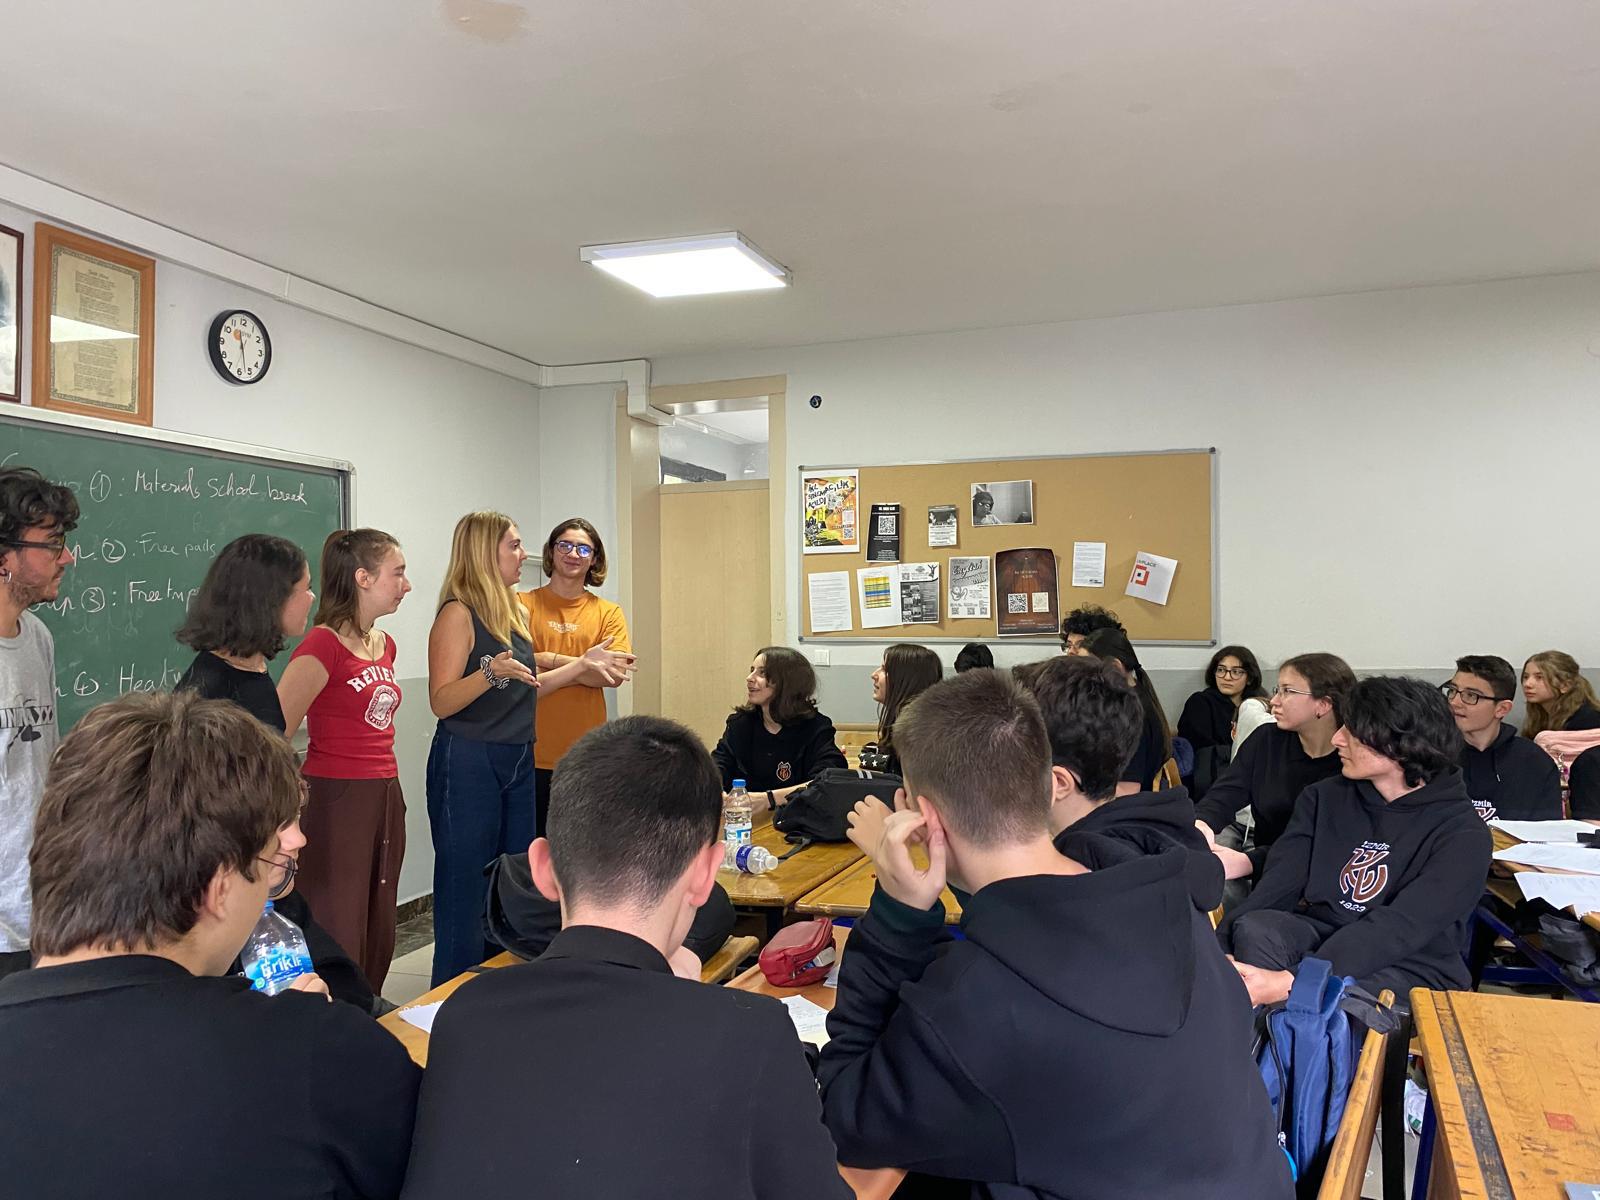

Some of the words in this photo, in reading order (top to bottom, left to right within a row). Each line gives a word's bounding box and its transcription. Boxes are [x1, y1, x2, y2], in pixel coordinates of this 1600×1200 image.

[208, 472, 259, 498] School
[267, 475, 307, 505] break
[138, 532, 179, 556] Free
[129, 580, 162, 603] Free
